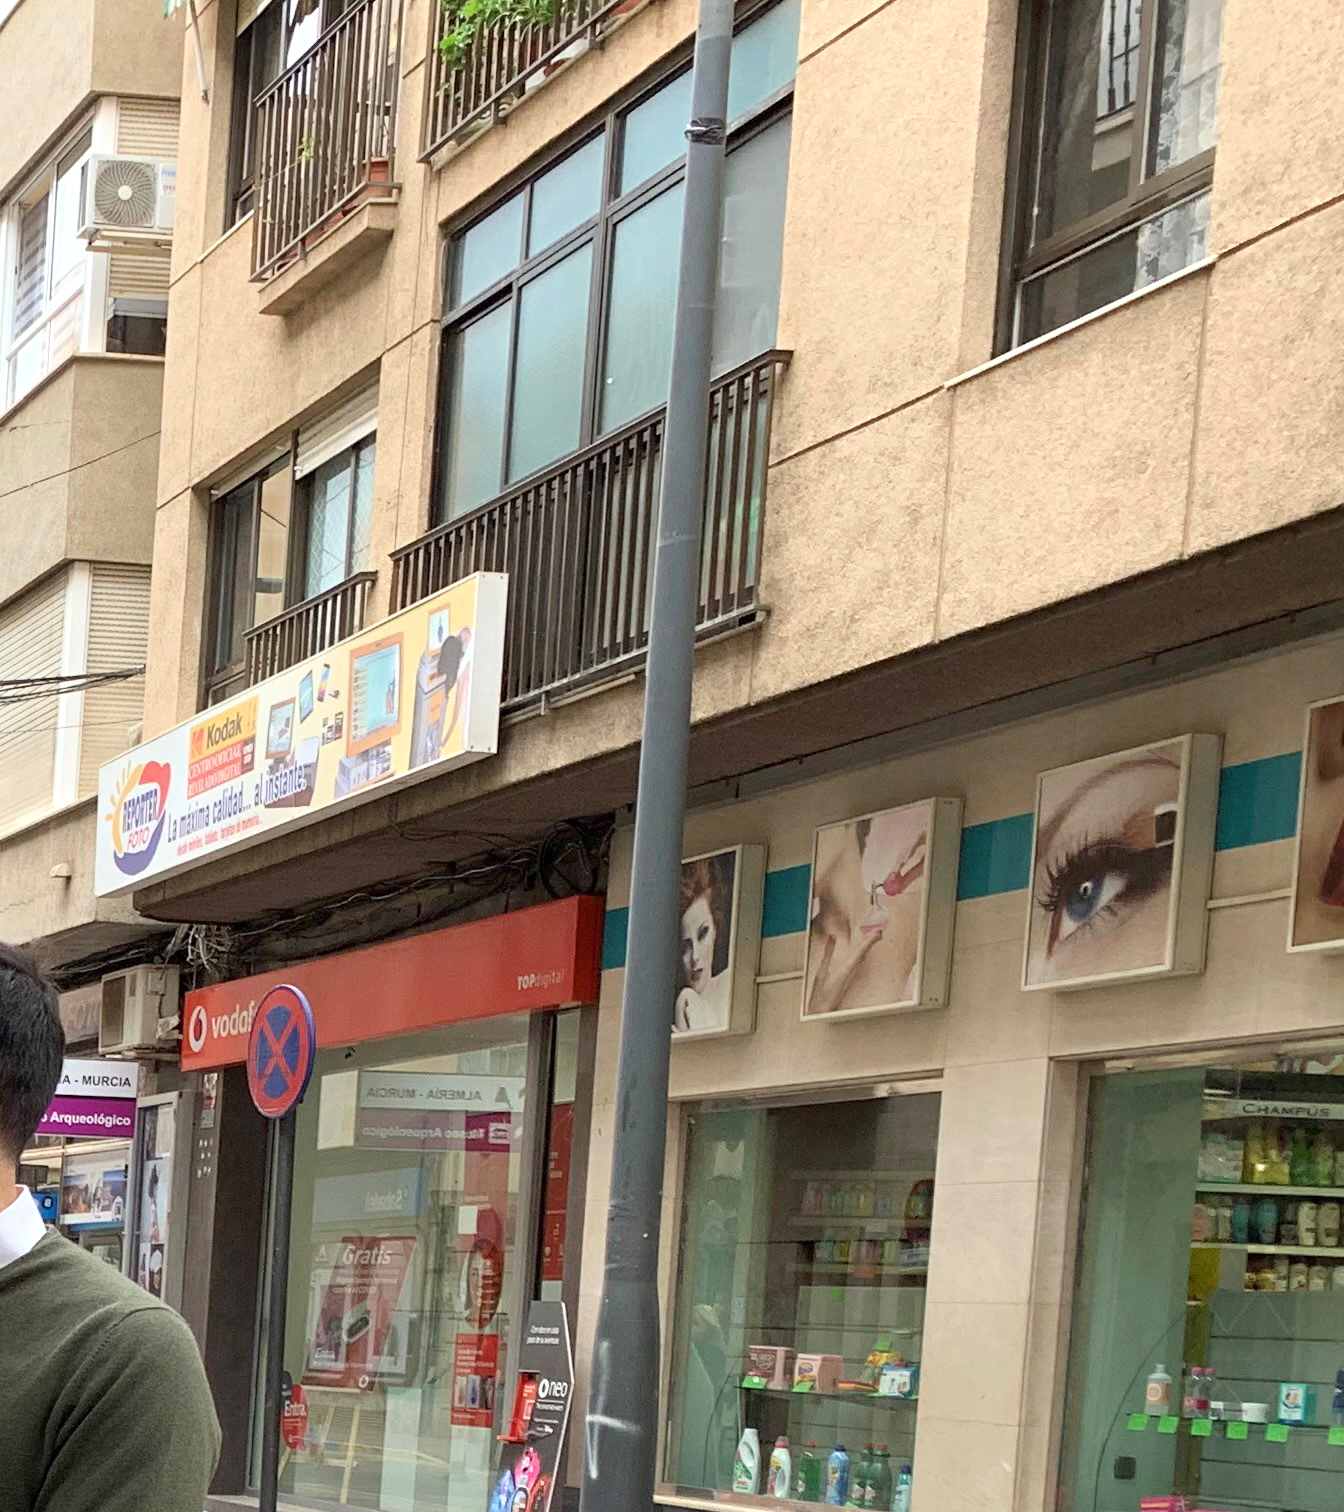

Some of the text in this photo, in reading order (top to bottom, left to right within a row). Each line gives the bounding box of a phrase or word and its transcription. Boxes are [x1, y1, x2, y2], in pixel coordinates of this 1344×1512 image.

[206, 712, 242, 749] Kodak
[123, 788, 158, 833] REPORTER
[127, 826, 150, 850] FOTO
[168, 812, 177, 843] La
[211, 1000, 255, 1039] vodaf
[82, 1075, 131, 1087] MURCIA
[50, 1111, 131, 1127] Arqueológico
[343, 1244, 393, 1265] Gratis
